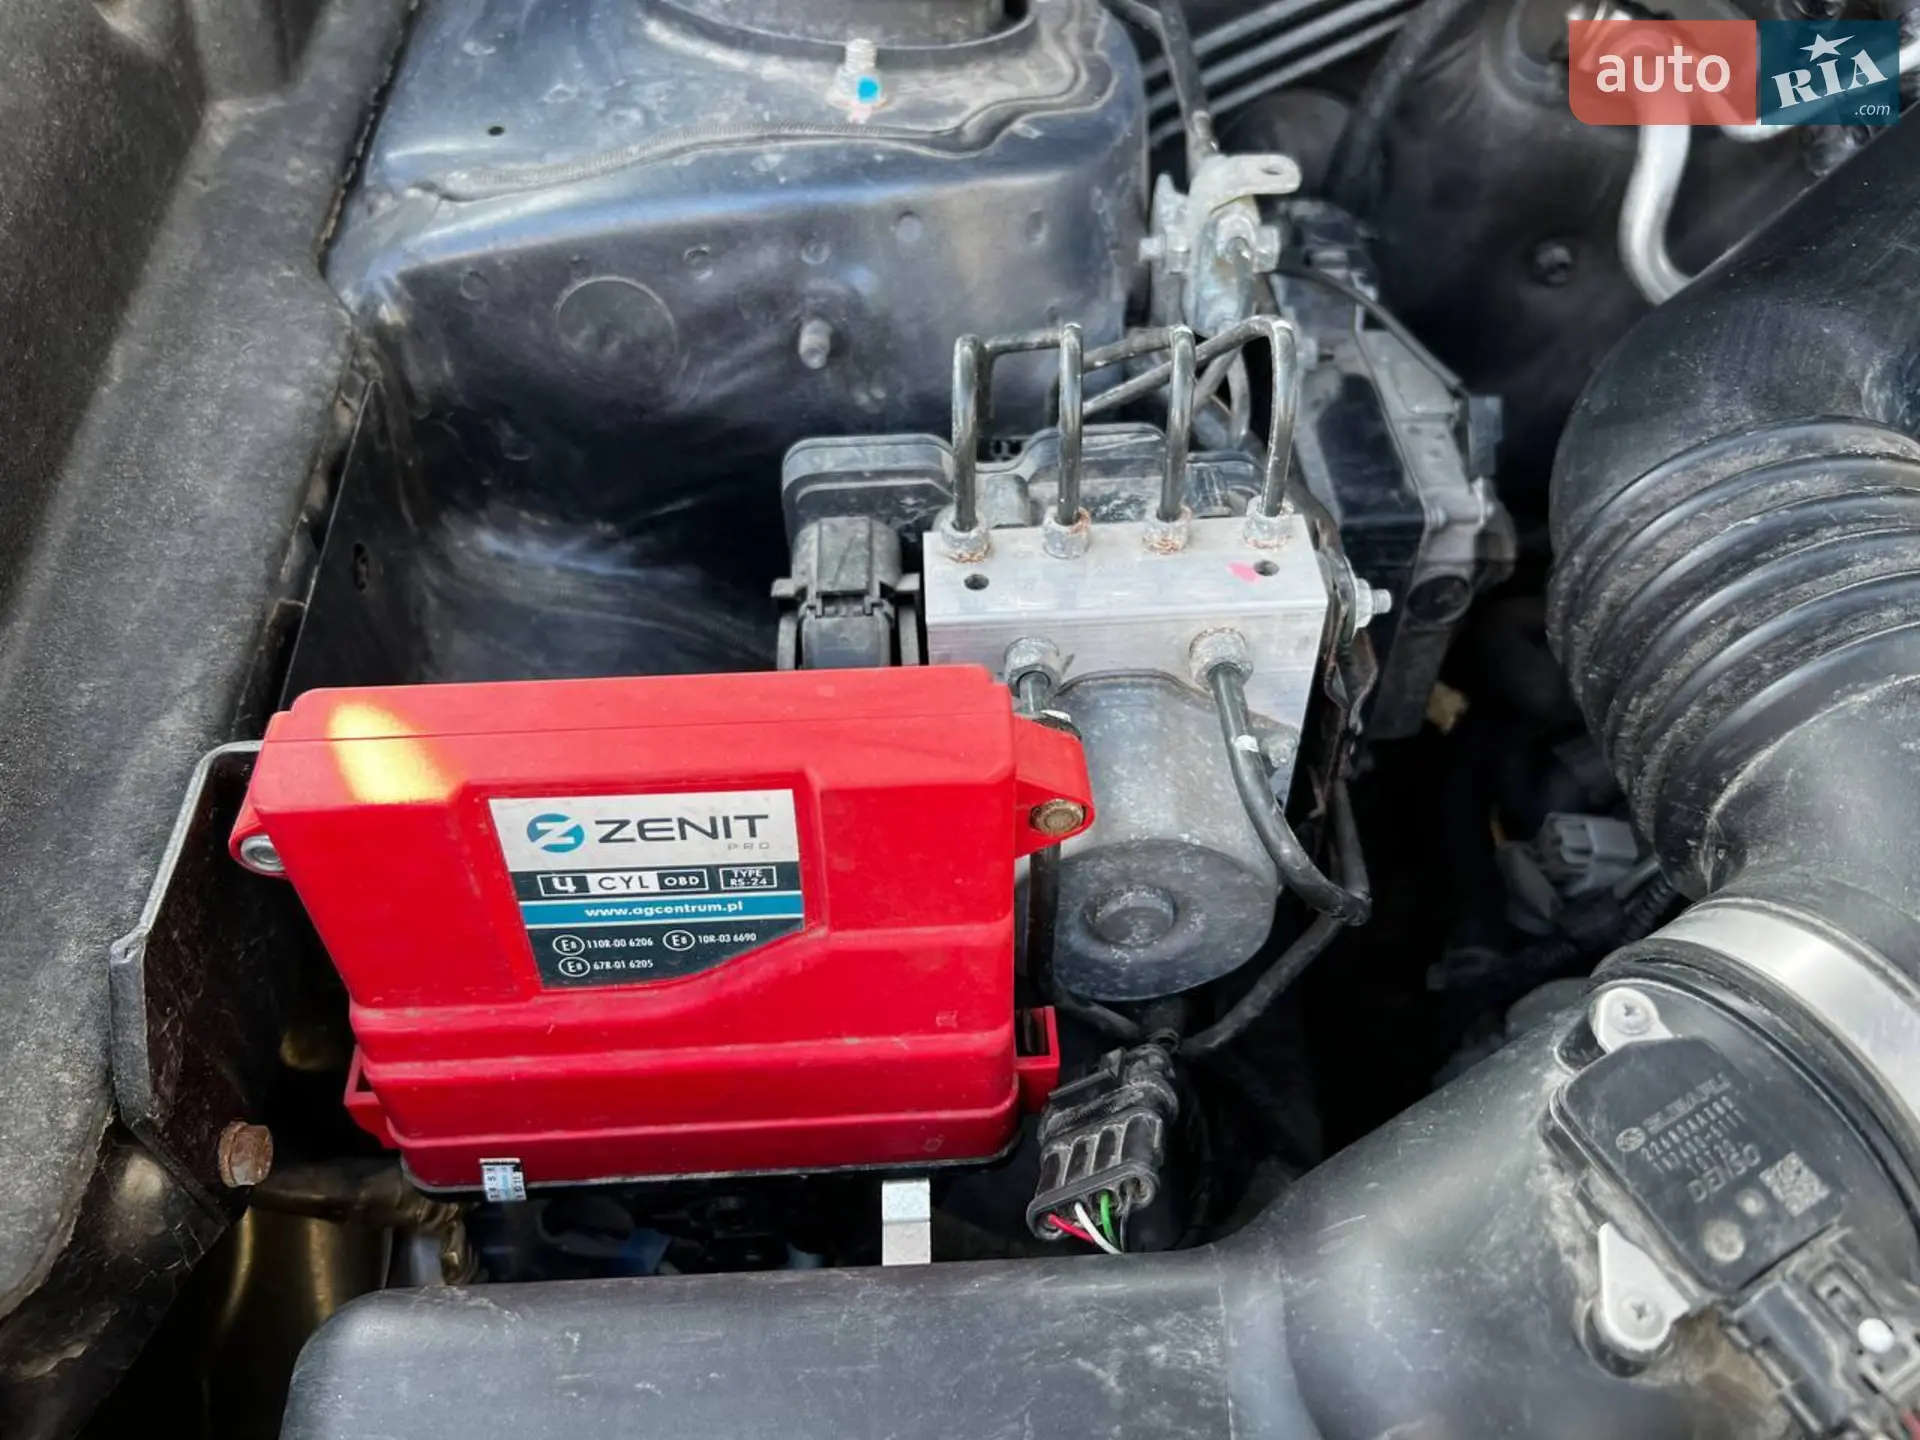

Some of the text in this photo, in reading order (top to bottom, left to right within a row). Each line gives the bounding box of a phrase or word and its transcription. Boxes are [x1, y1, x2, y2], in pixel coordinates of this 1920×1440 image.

[594, 814, 769, 843] ZENIT
[727, 842, 770, 851] PRO
[731, 869, 763, 878] TYPE
[552, 875, 700, 893] 4 CYL OBD
[730, 877, 768, 887] RS-24
[628, 937, 654, 948] 6206
[698, 934, 731, 945] 10R-03
[732, 932, 757, 943] 6690
[628, 958, 654, 970] 6205
